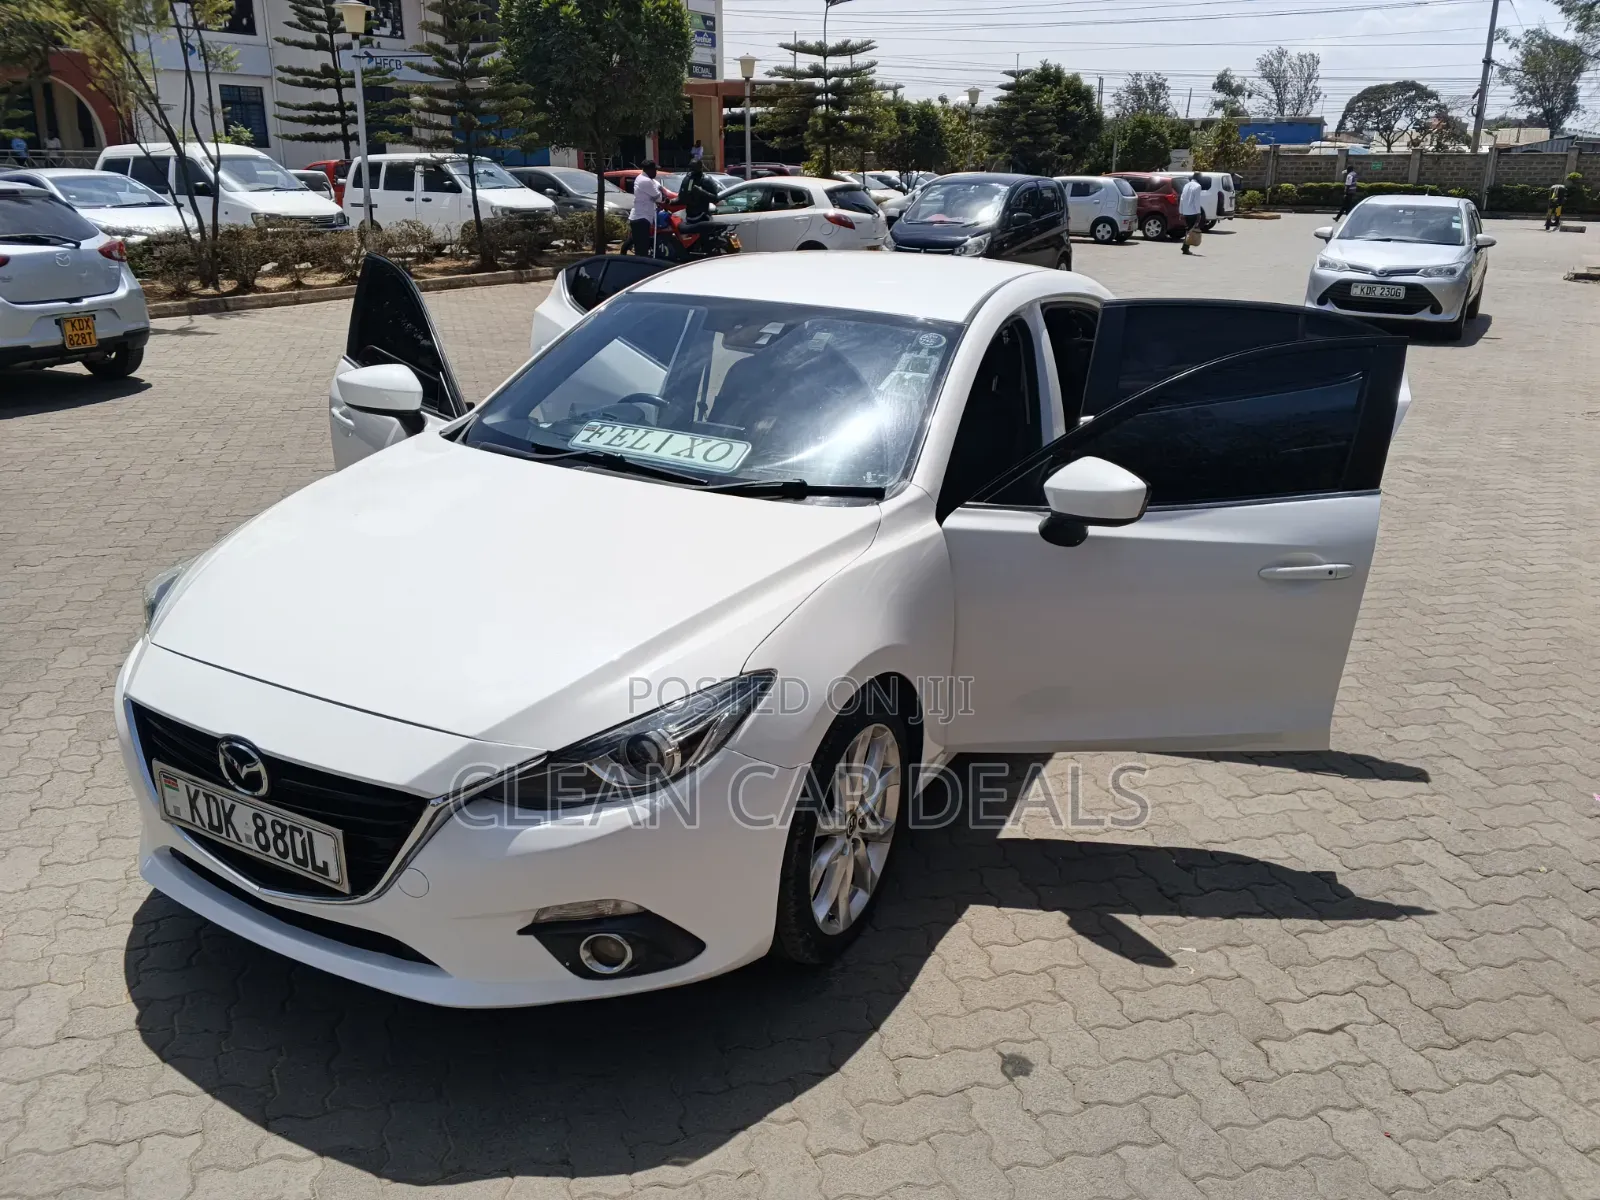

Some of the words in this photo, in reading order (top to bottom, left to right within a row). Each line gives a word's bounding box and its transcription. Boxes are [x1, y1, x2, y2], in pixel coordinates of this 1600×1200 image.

[694, 34, 712, 44] Avenue
[375, 57, 402, 70] HFCB
[692, 65, 712, 75] DECIMAL
[1360, 285, 1377, 296] KDR
[1379, 287, 1402, 298] 230G
[70, 317, 92, 332] KDX
[68, 332, 92, 346] 828T
[581, 423, 735, 463] FELIXO
[184, 783, 243, 843] KDK
[251, 811, 330, 877] 880L
